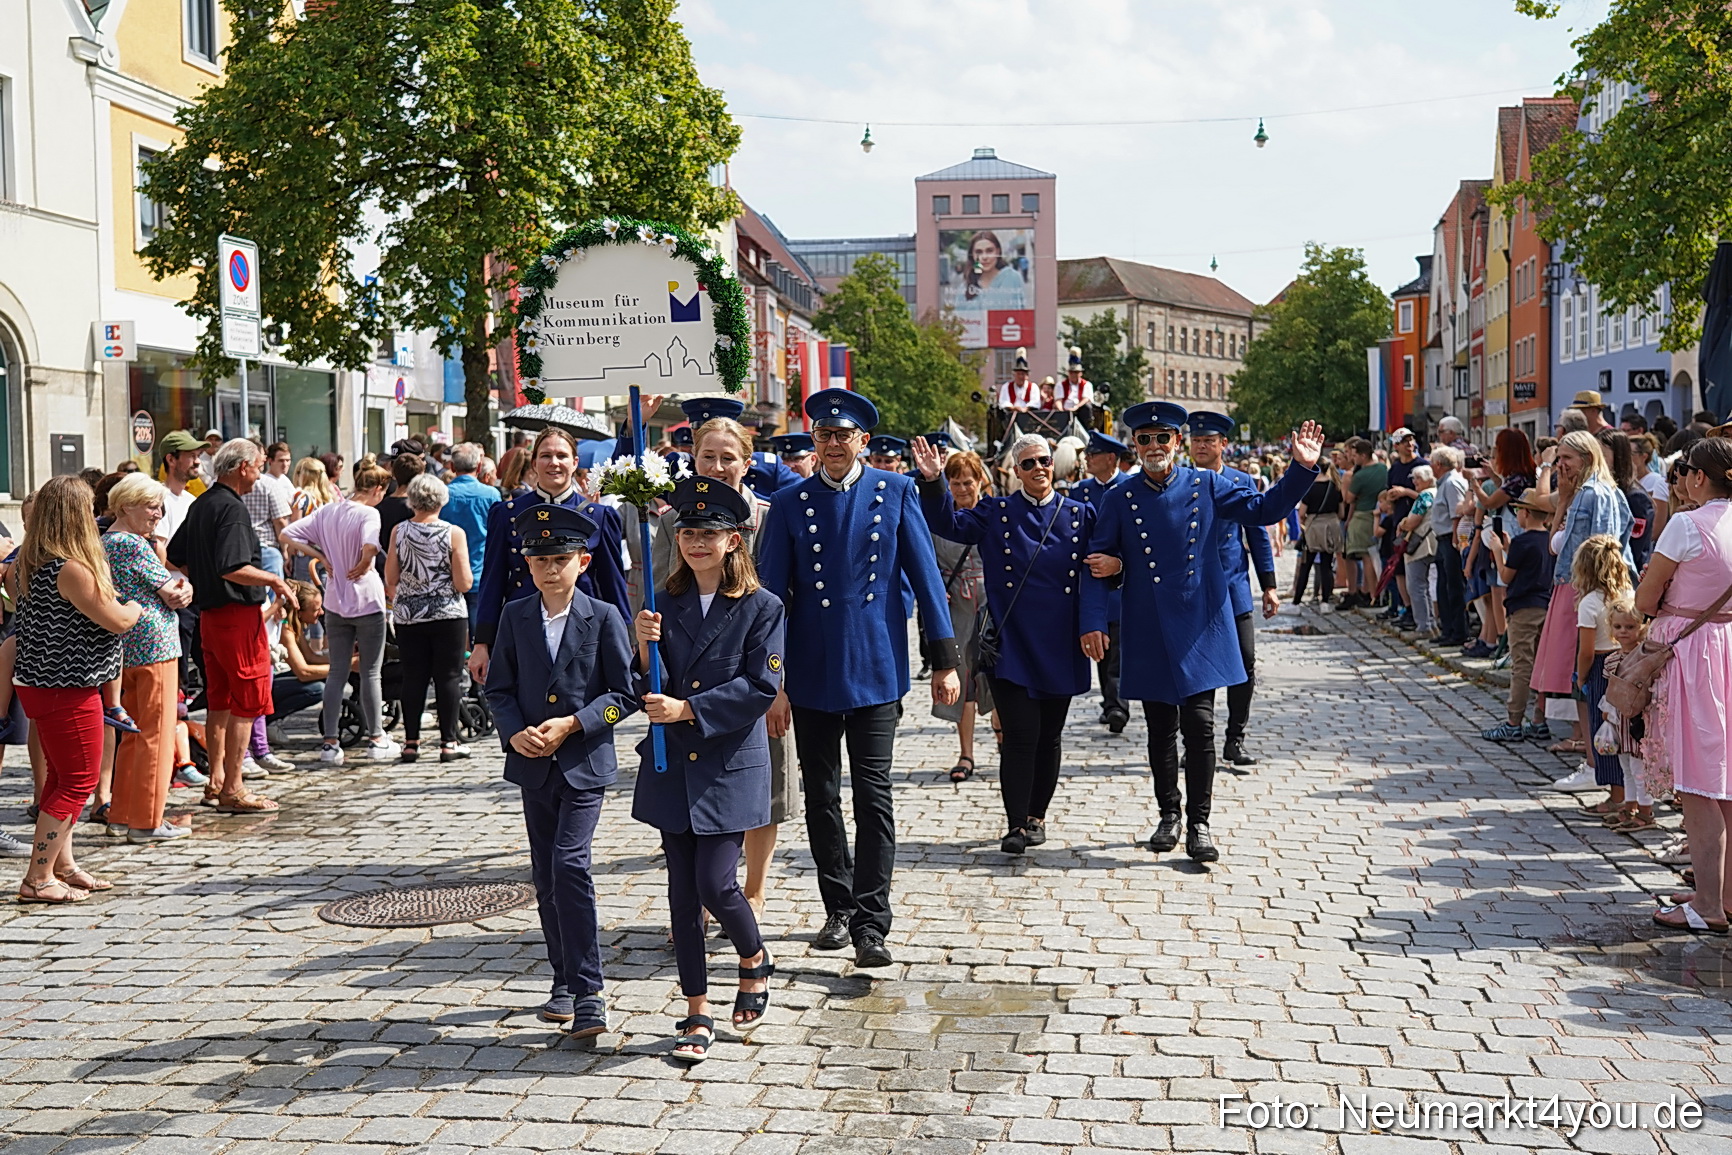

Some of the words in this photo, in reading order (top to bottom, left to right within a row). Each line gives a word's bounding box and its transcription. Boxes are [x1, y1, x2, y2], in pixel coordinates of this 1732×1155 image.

[232, 294, 250, 307] ZONE
[542, 296, 604, 309] Museum
[614, 294, 640, 307] für
[543, 312, 666, 328] Kommunikation
[545, 332, 621, 347] Nürnberg
[1633, 373, 1662, 389] C&A
